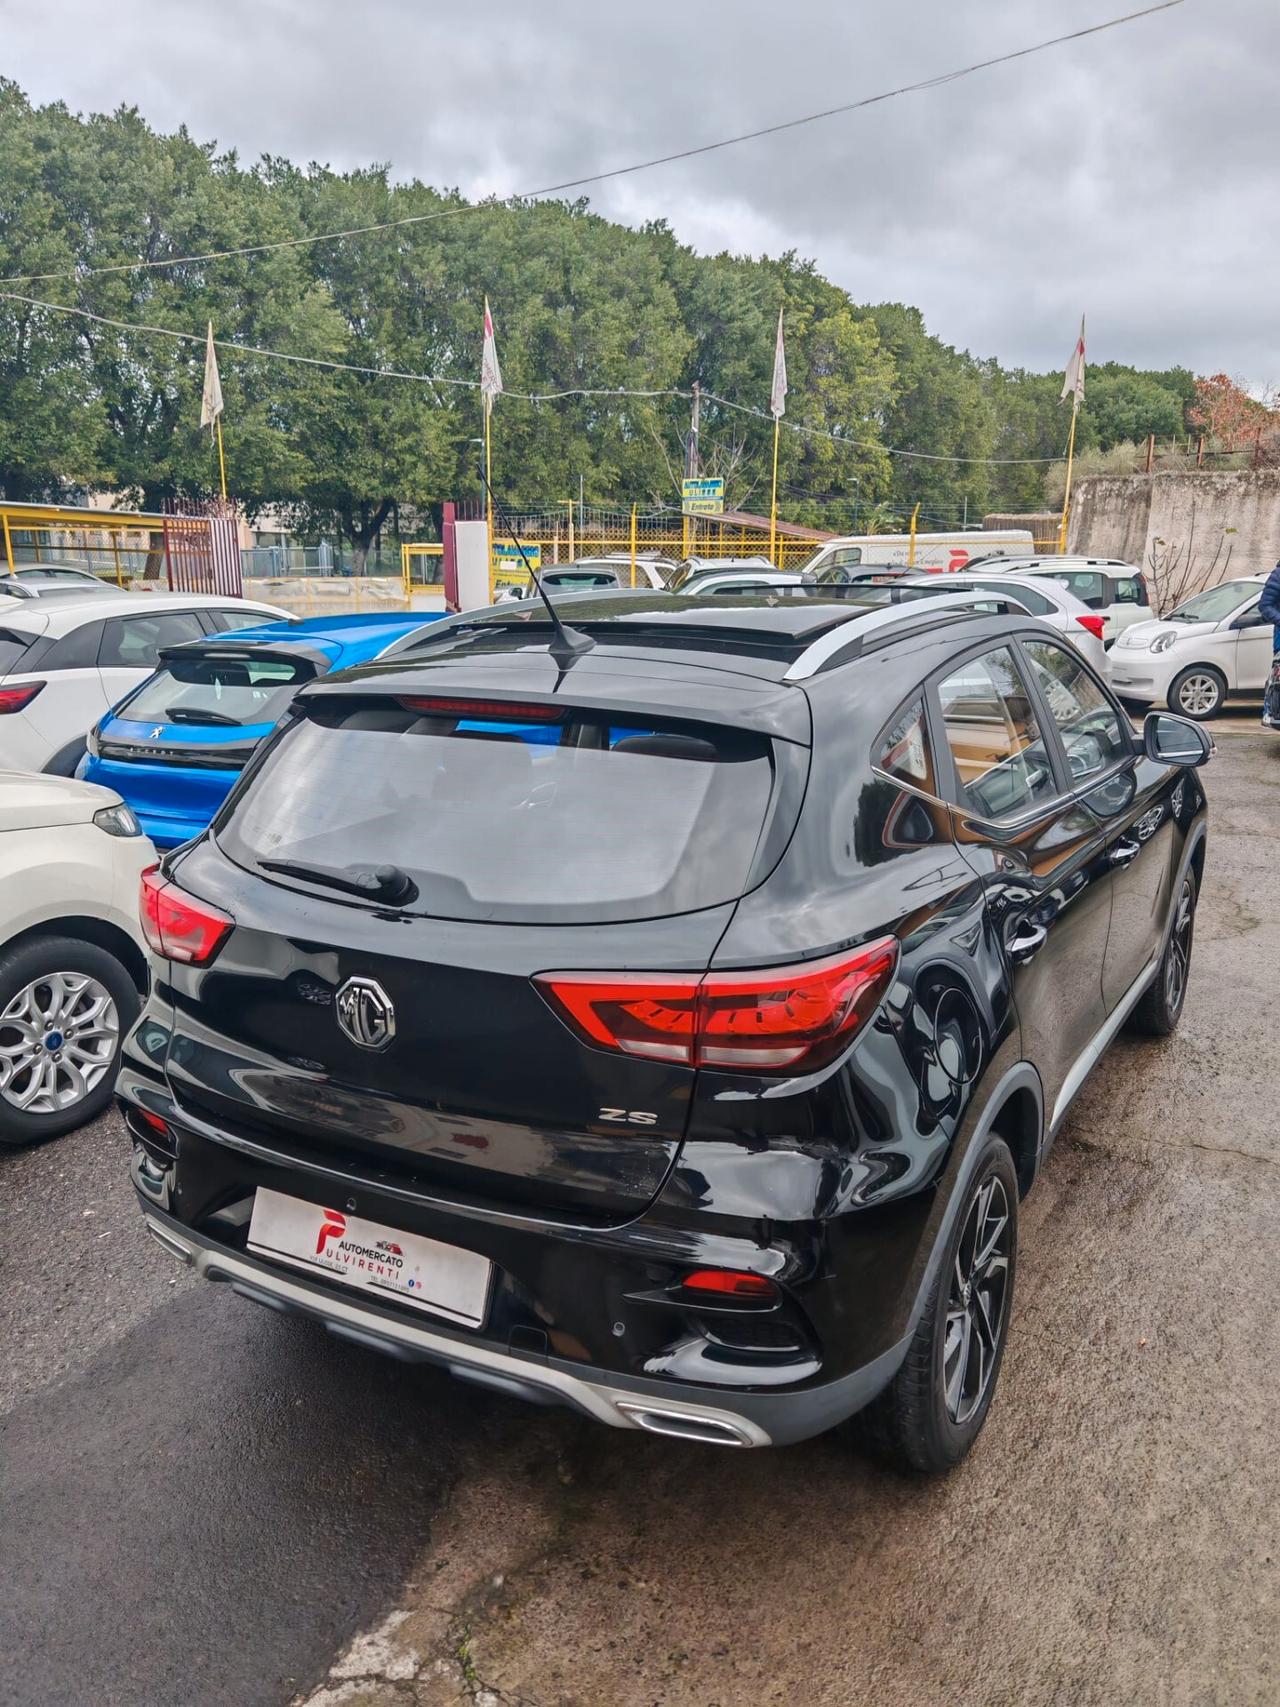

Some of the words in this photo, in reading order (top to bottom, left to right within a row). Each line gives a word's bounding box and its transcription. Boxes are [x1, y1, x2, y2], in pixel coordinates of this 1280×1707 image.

[339, 986, 387, 1044] MG
[598, 1107, 658, 1125] ZS
[338, 1240, 403, 1269] AUTOMERCATO
